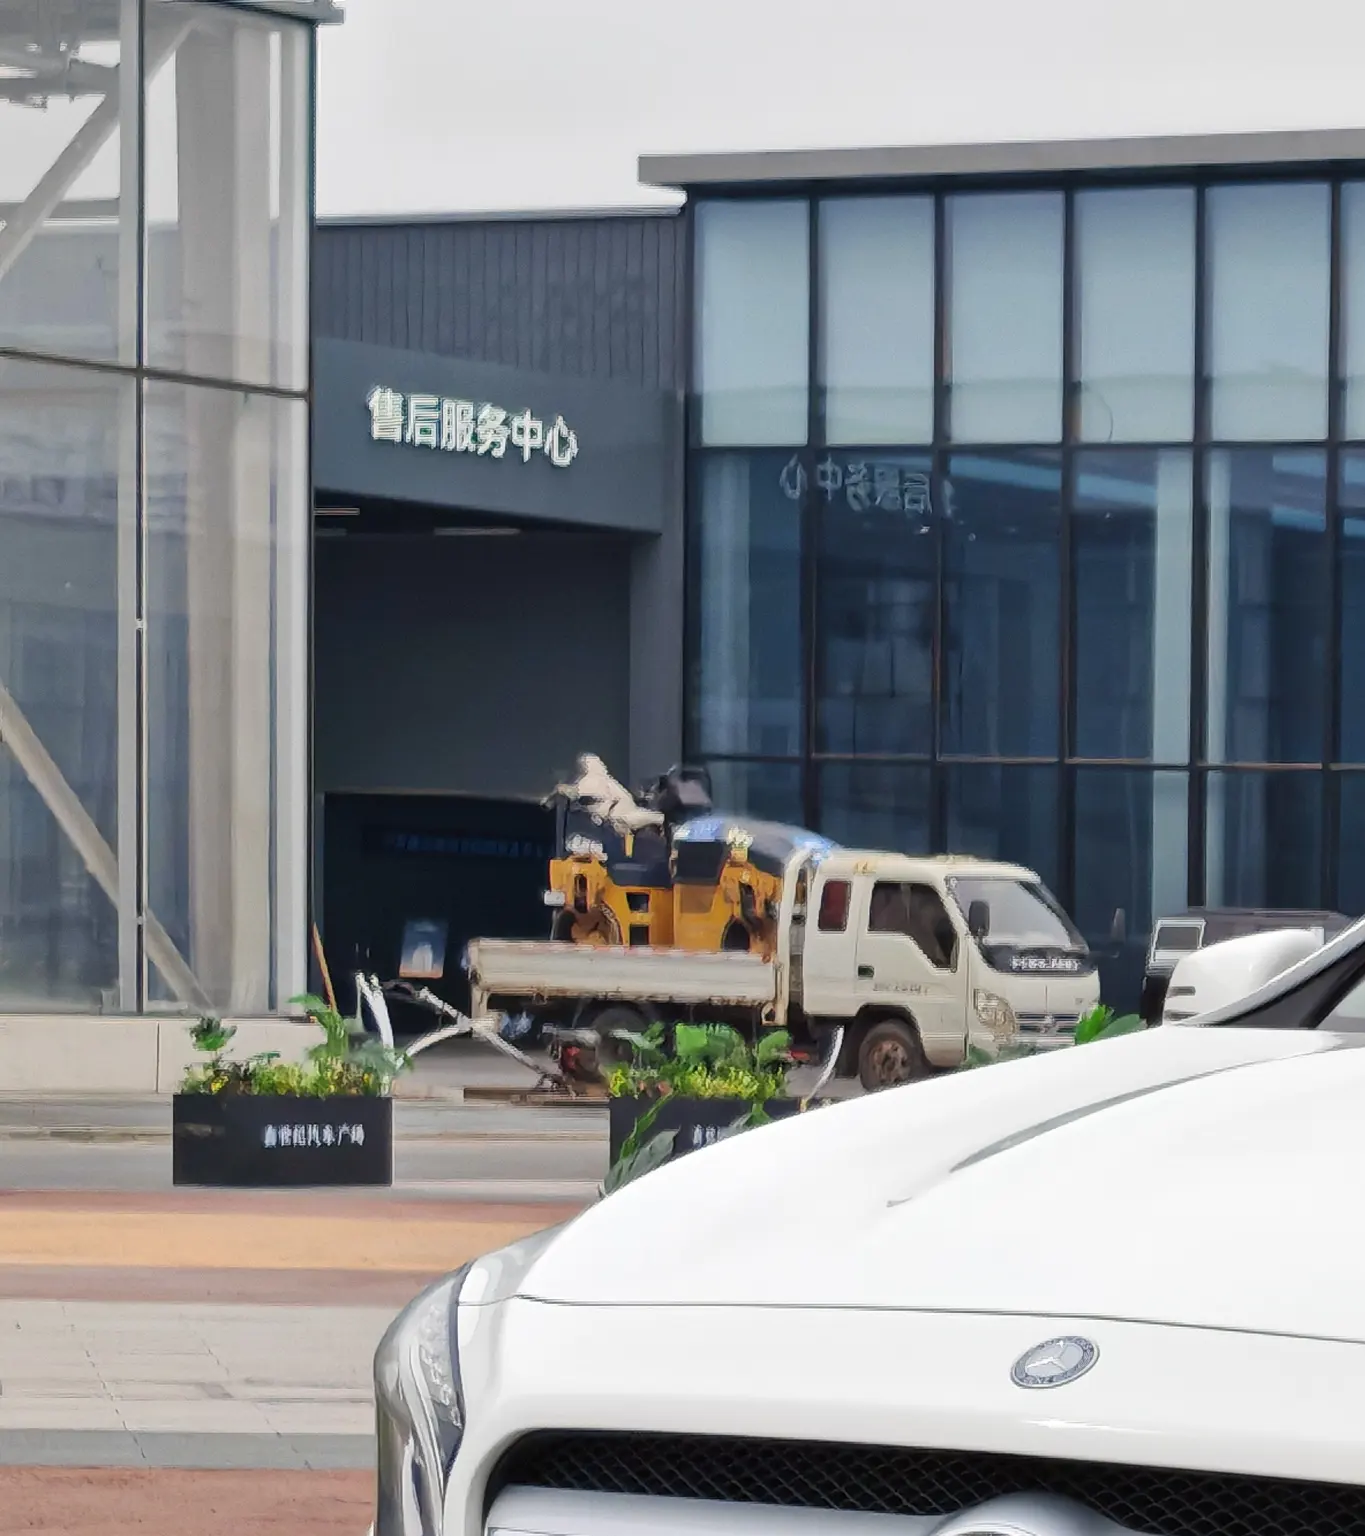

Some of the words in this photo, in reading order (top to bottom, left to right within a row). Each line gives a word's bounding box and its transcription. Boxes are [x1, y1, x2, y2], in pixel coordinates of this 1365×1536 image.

[367, 385, 579, 467] 售后服务中心
